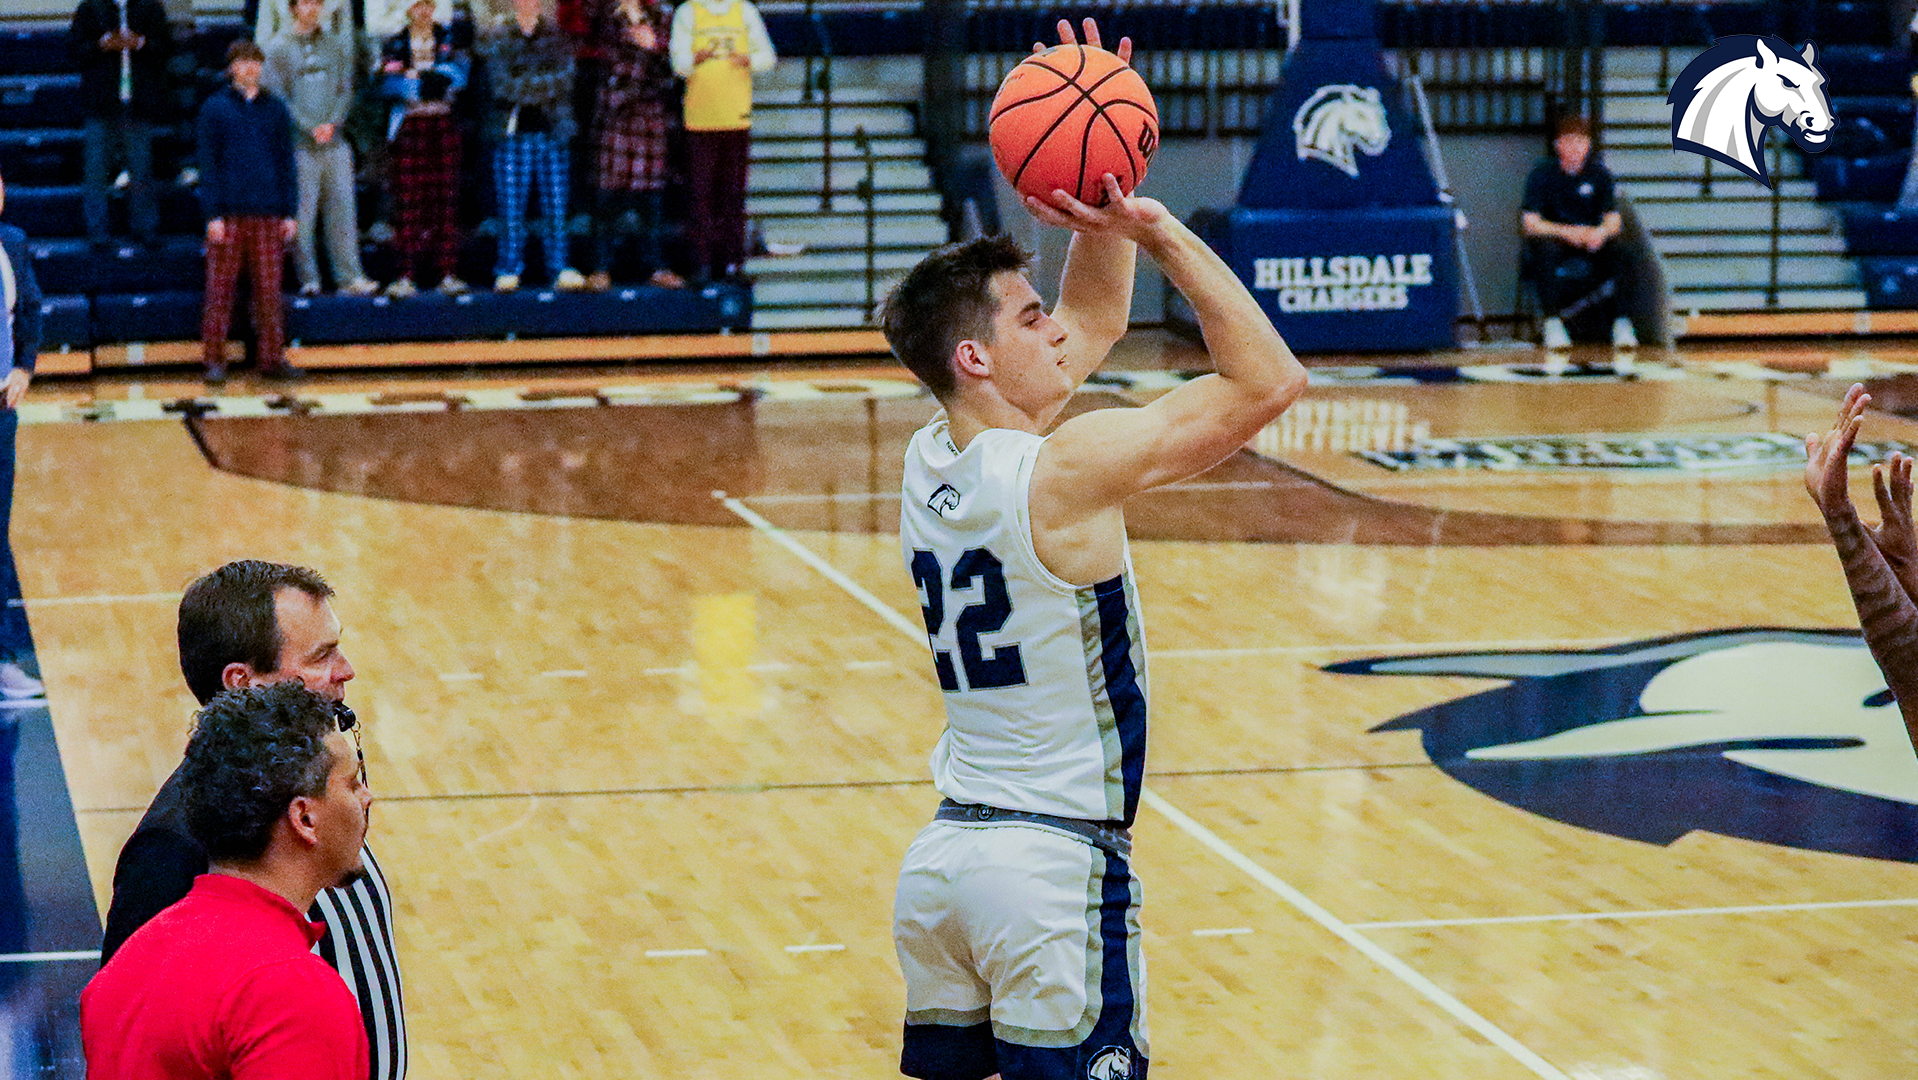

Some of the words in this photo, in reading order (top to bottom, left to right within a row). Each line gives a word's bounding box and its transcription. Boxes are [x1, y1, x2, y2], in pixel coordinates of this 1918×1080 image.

[1254, 254, 1433, 289] HILLSDALE
[1278, 287, 1409, 313] CHARGERS
[911, 546, 1029, 692] 22
